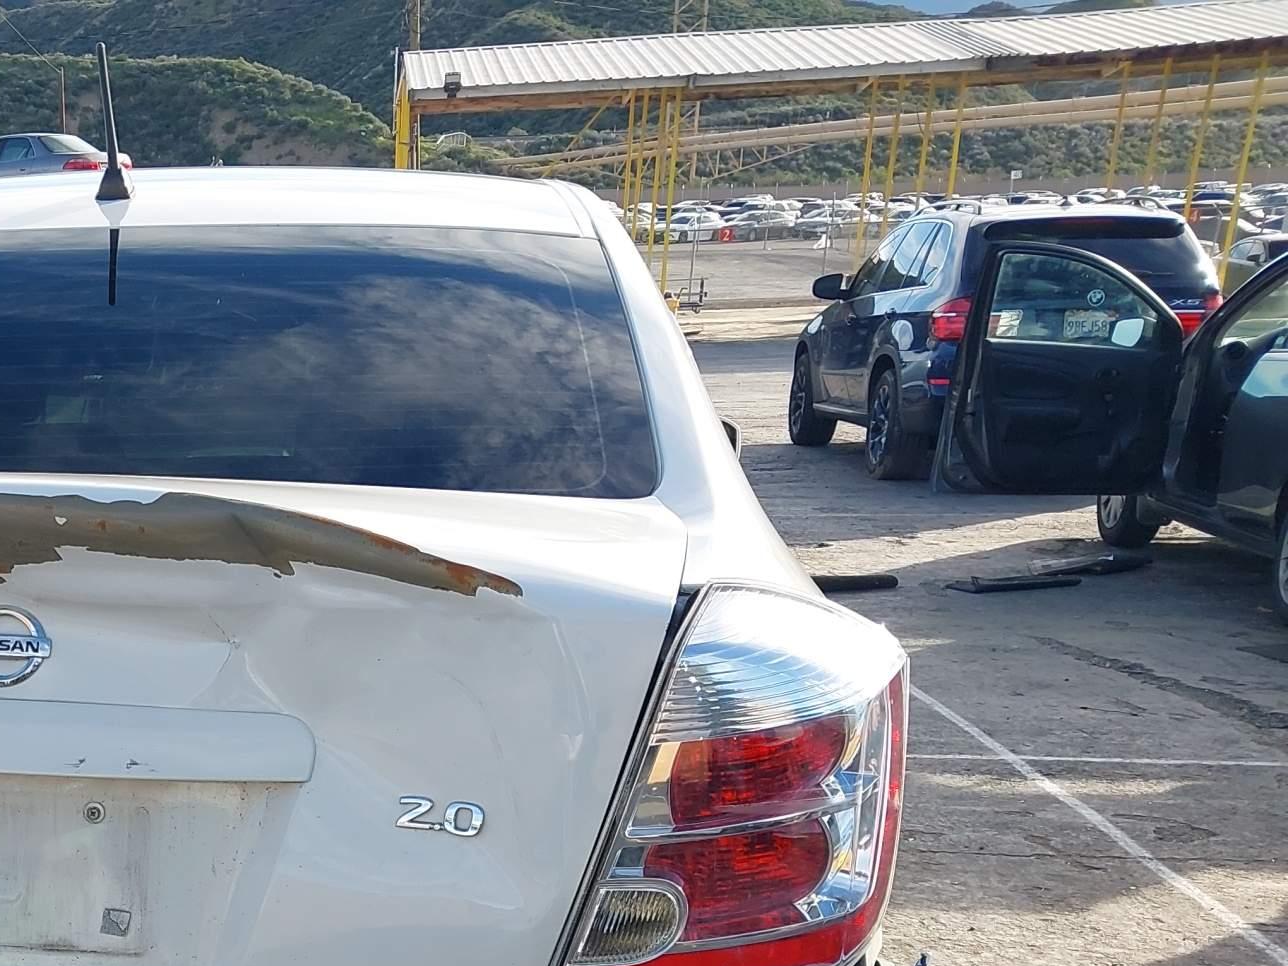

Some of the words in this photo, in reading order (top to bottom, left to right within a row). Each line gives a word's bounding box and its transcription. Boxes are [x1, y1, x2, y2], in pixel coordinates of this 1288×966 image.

[722, 229, 730, 241] 2
[1169, 298, 1205, 306] X5
[395, 796, 485, 837] 2.0
